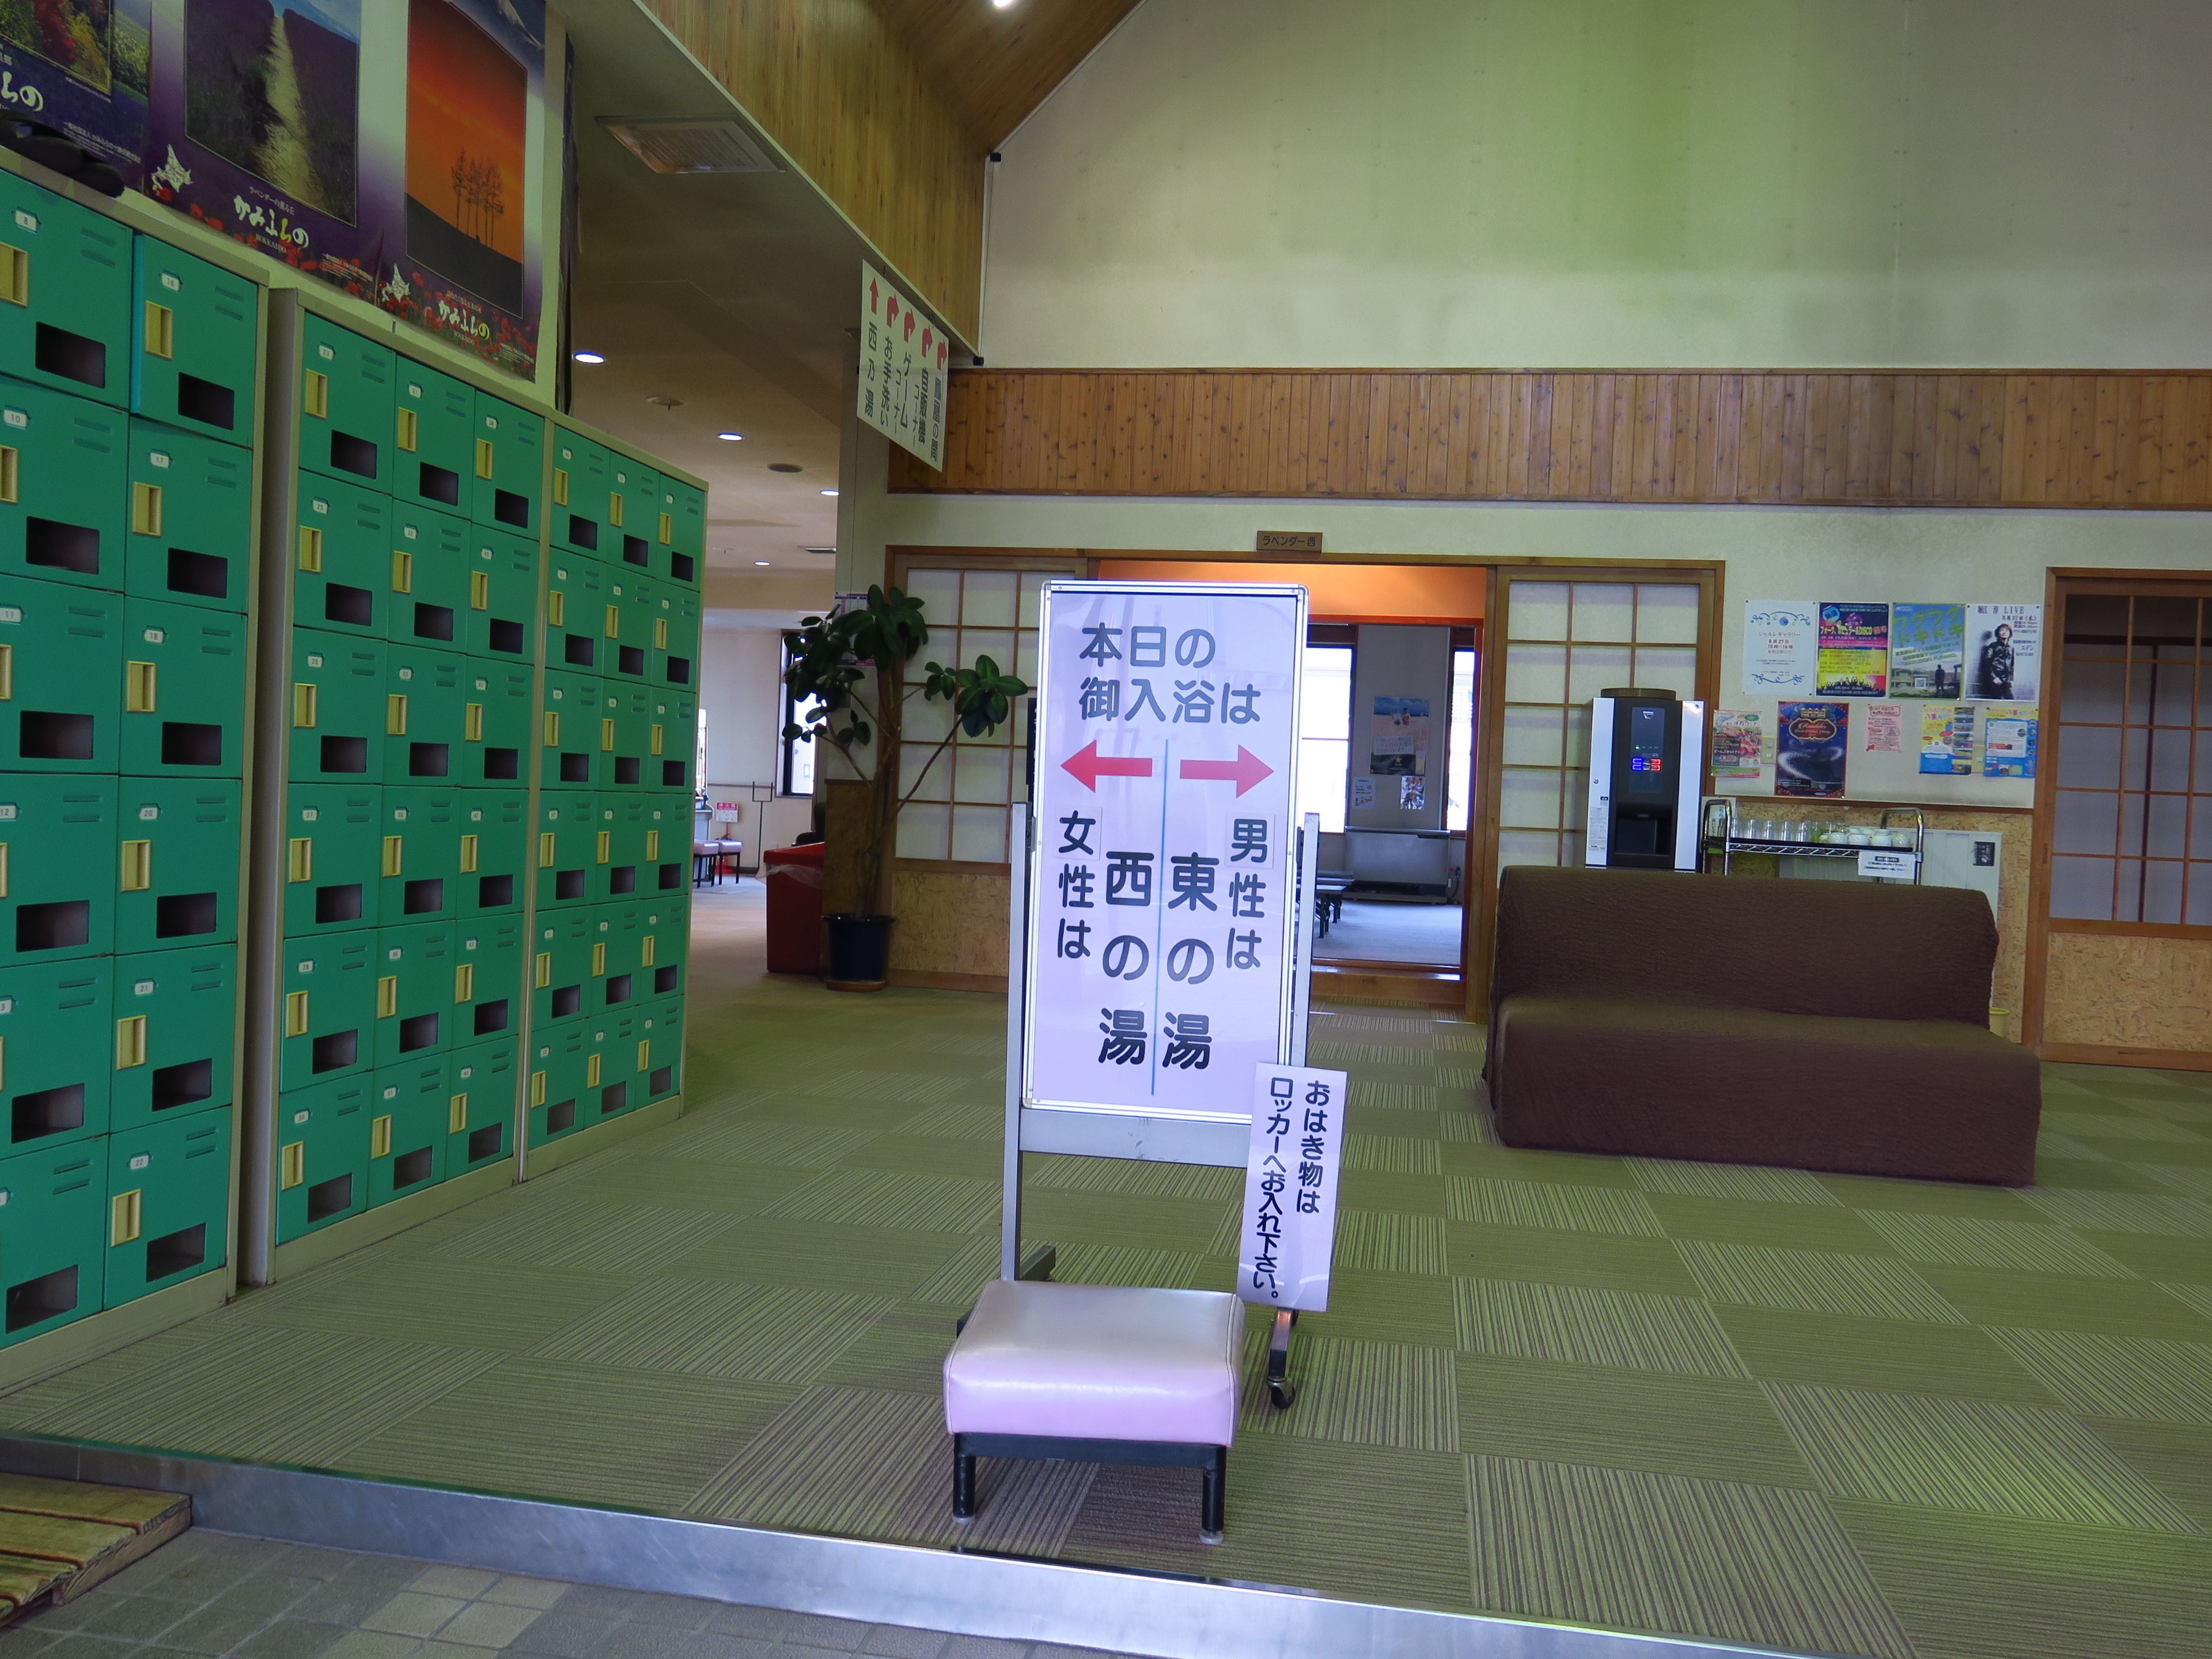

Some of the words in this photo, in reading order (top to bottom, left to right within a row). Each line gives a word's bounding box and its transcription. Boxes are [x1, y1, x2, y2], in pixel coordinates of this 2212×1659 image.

[24, 217, 29, 225] 8
[233, 195, 309, 248] かみふらの
[167, 278, 175, 287] 16
[438, 300, 490, 340] かみふらの
[865, 321, 878, 418] 西乃湯
[880, 335, 893, 427] お手洗い
[900, 351, 912, 429] ゲーム
[12, 414, 21, 423] 10
[893, 368, 902, 435] コーナー
[918, 367, 929, 445] 自販機
[1263, 536, 1316, 547] ラベンダー西
[150, 632, 158, 640] 18
[2003, 606, 2025, 614] LIVE
[1078, 622, 1217, 669] 本日の
[1079, 677, 1262, 725] 御入浴は
[1056, 809, 1096, 960] 女性は
[1226, 818, 1268, 970] 男性は
[1097, 851, 1155, 1067] 西の湯
[1161, 851, 1220, 1071] 東の湯
[135, 1159, 144, 1167] 22
[1296, 1080, 1331, 1214] おはき物は
[1253, 1077, 1294, 1300] ロッカーへお入れ下さい。
